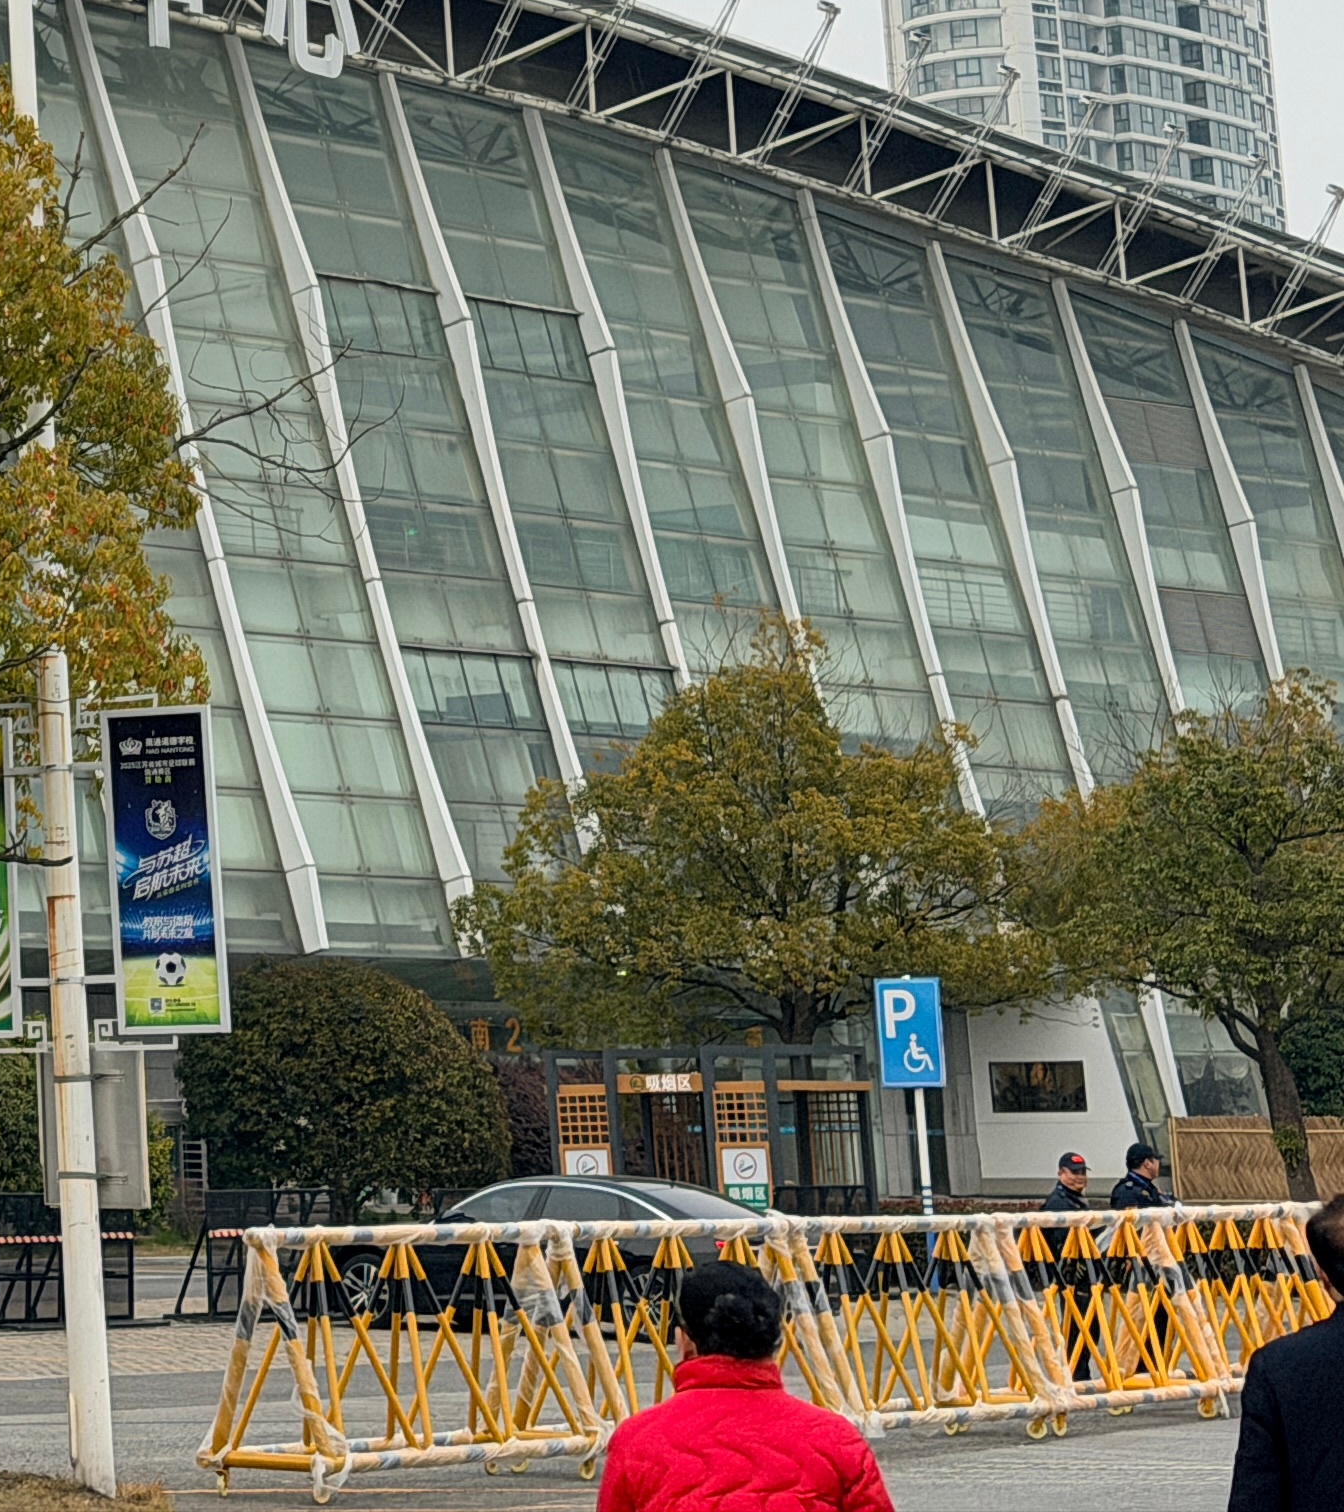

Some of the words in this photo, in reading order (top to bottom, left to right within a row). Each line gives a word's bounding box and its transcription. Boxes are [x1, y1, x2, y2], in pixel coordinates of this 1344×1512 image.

[883, 989, 916, 1038] P
[645, 1074, 693, 1093] 吸烟区
